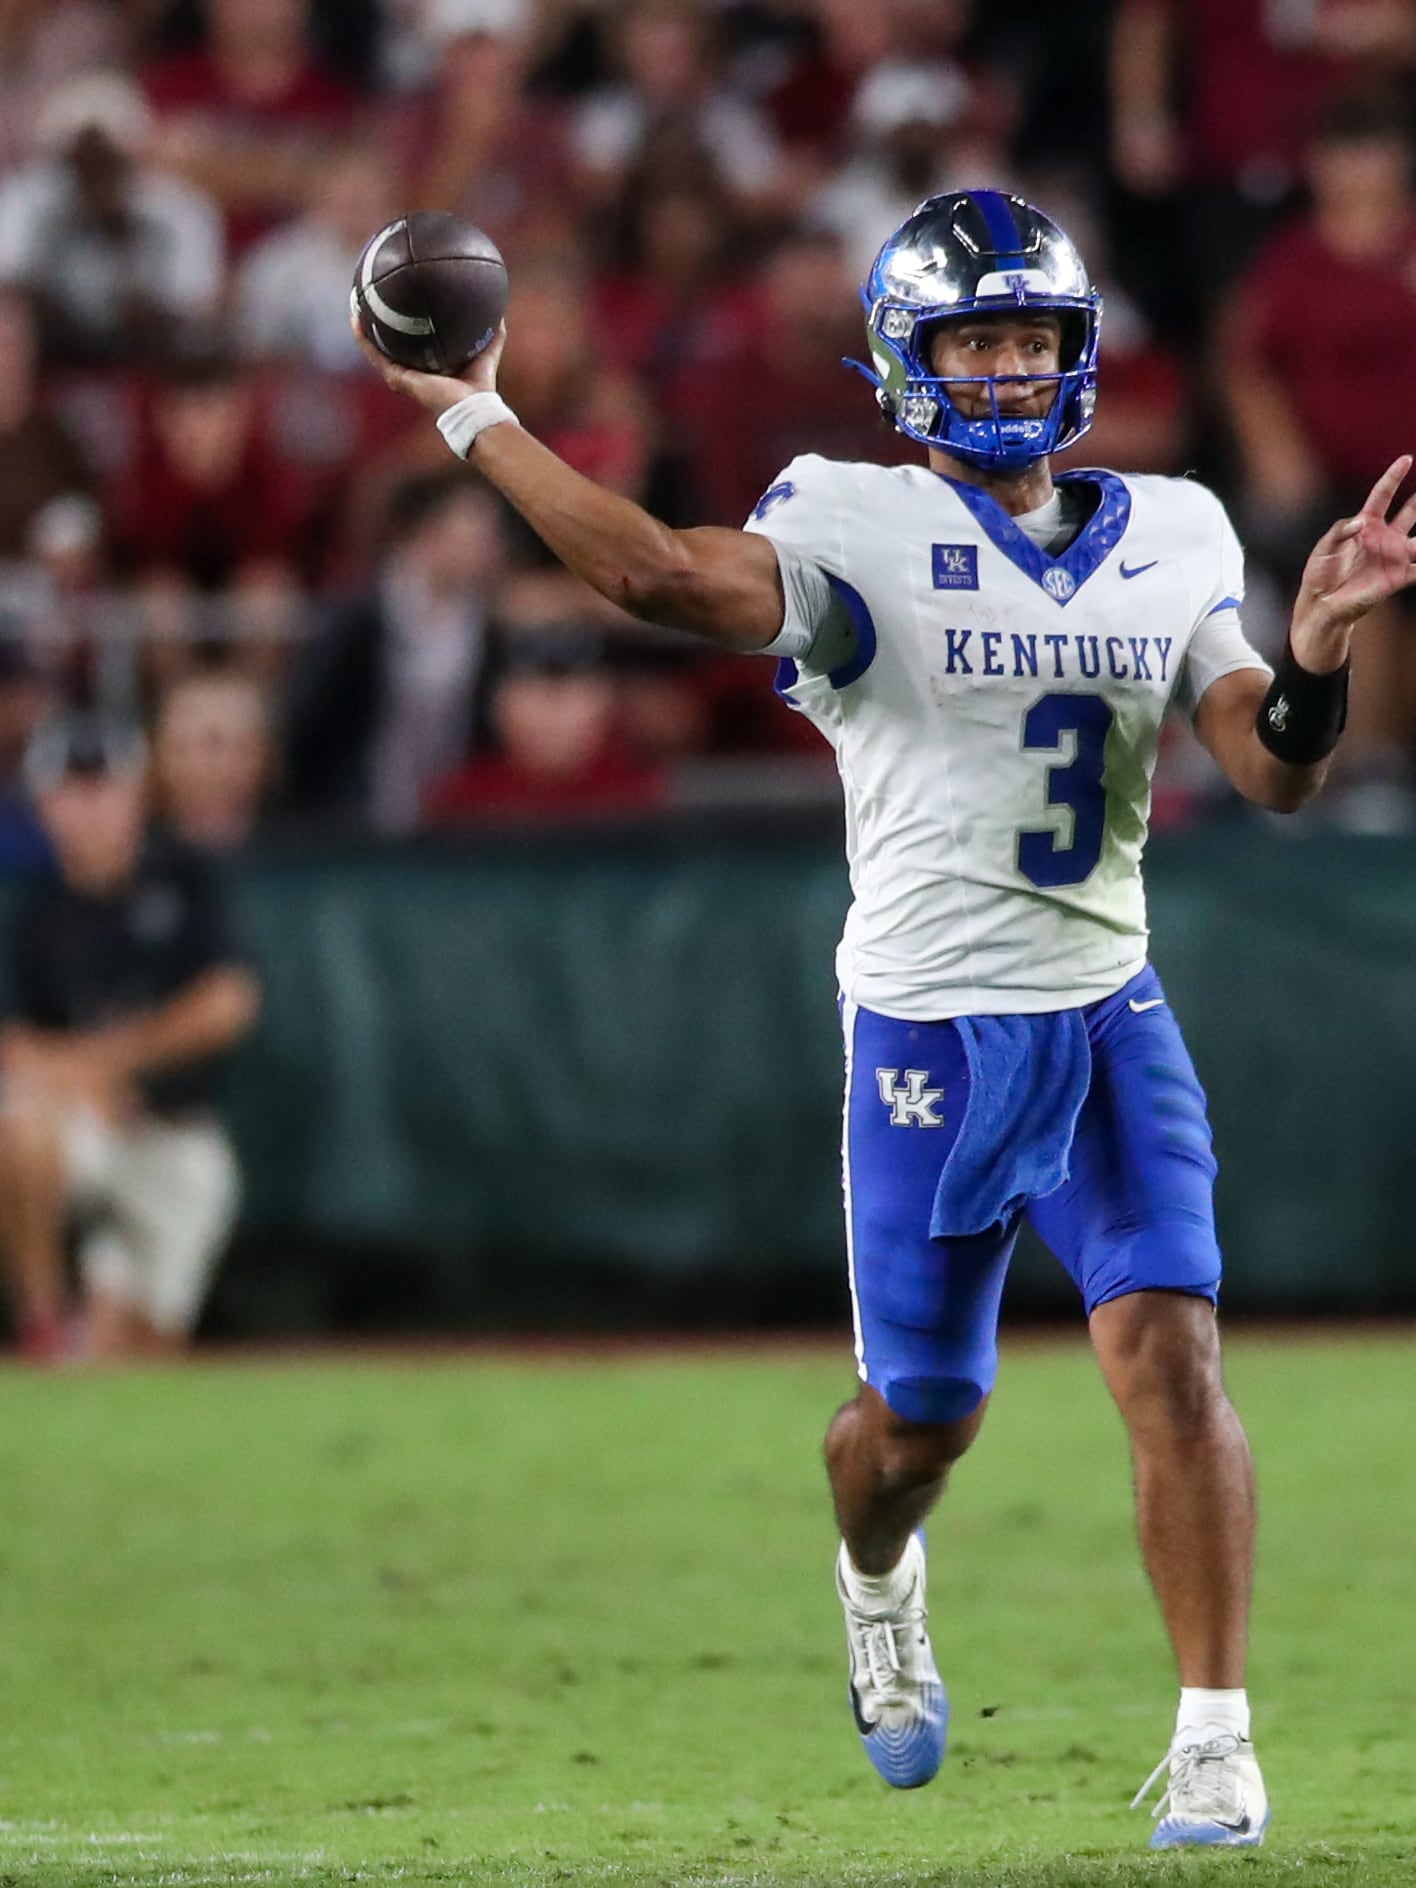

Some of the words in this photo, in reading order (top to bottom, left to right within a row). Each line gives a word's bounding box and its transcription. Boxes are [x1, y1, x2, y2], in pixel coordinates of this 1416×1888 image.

[945, 629, 1172, 682] KENTUCKY
[1015, 693, 1115, 889] 3
[875, 1067, 945, 1128] UK
